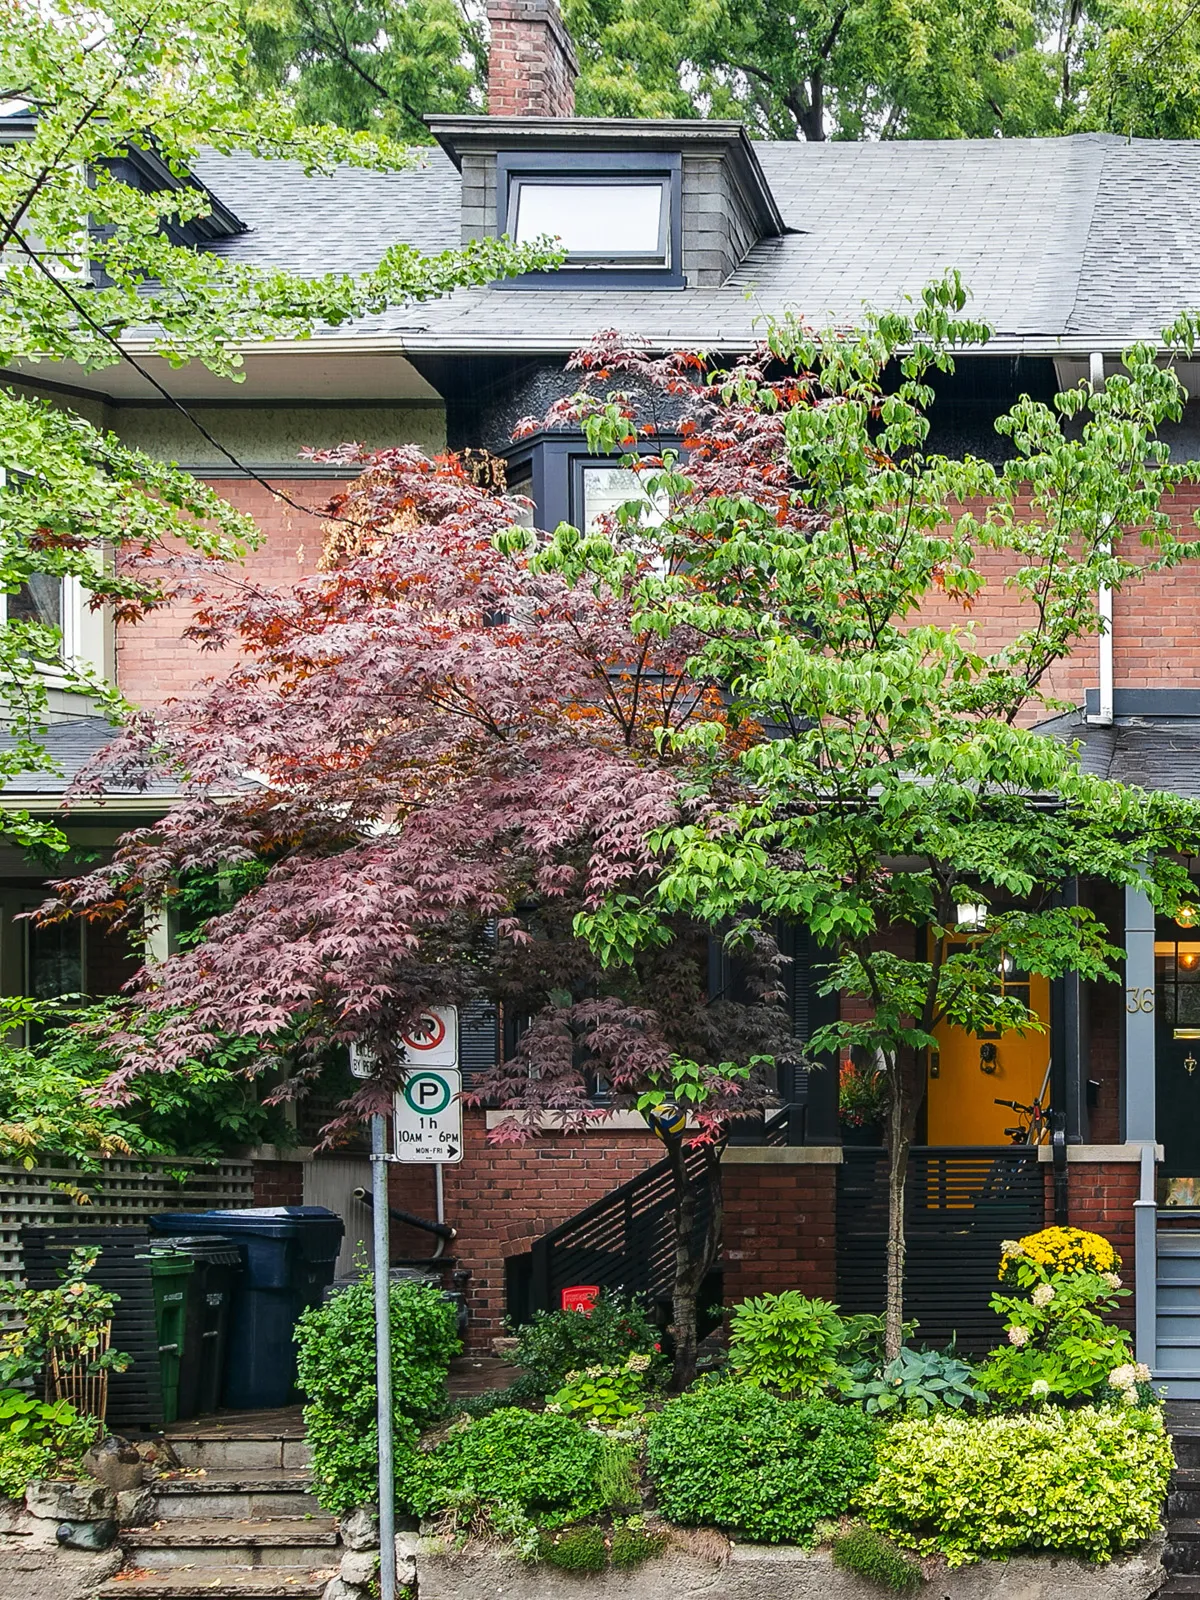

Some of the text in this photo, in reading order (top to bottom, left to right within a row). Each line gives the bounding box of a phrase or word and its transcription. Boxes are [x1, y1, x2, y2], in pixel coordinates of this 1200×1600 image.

[1126, 987, 1155, 1013] 36
[353, 1059, 361, 1071] BY
[419, 1083, 438, 1104] P
[419, 1117, 437, 1129] 1 h
[398, 1130, 422, 1142] 10AM
[439, 1131, 459, 1142] 6PM
